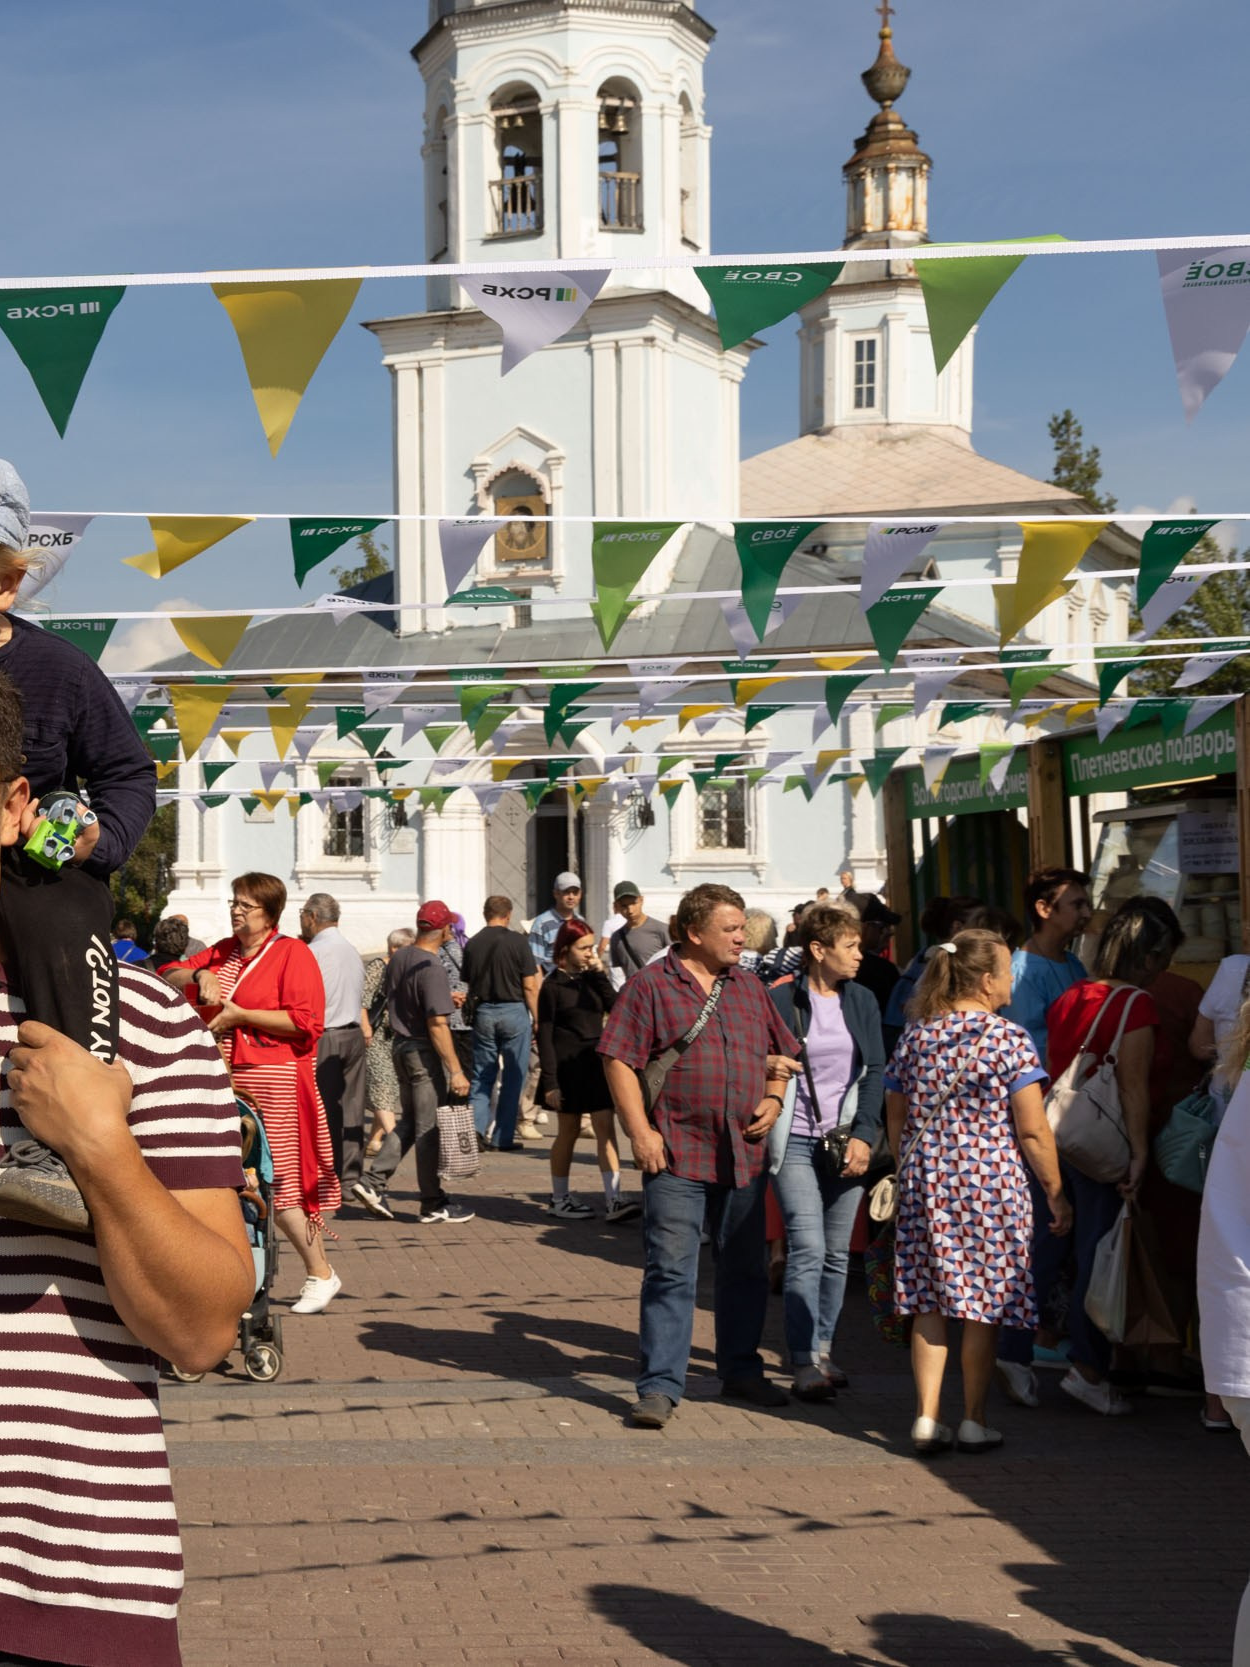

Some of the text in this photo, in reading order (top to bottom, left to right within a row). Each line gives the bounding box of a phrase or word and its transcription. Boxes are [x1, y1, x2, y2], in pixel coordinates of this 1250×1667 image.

[317, 525, 364, 535] РСХБ
[751, 526, 800, 541] СВОЁ
[894, 524, 939, 535] РСХБ
[1170, 523, 1211, 535] РСХБ
[28, 532, 74, 547] РСХБ
[618, 532, 663, 542] РСХБ
[1165, 729, 1236, 766] подворь
